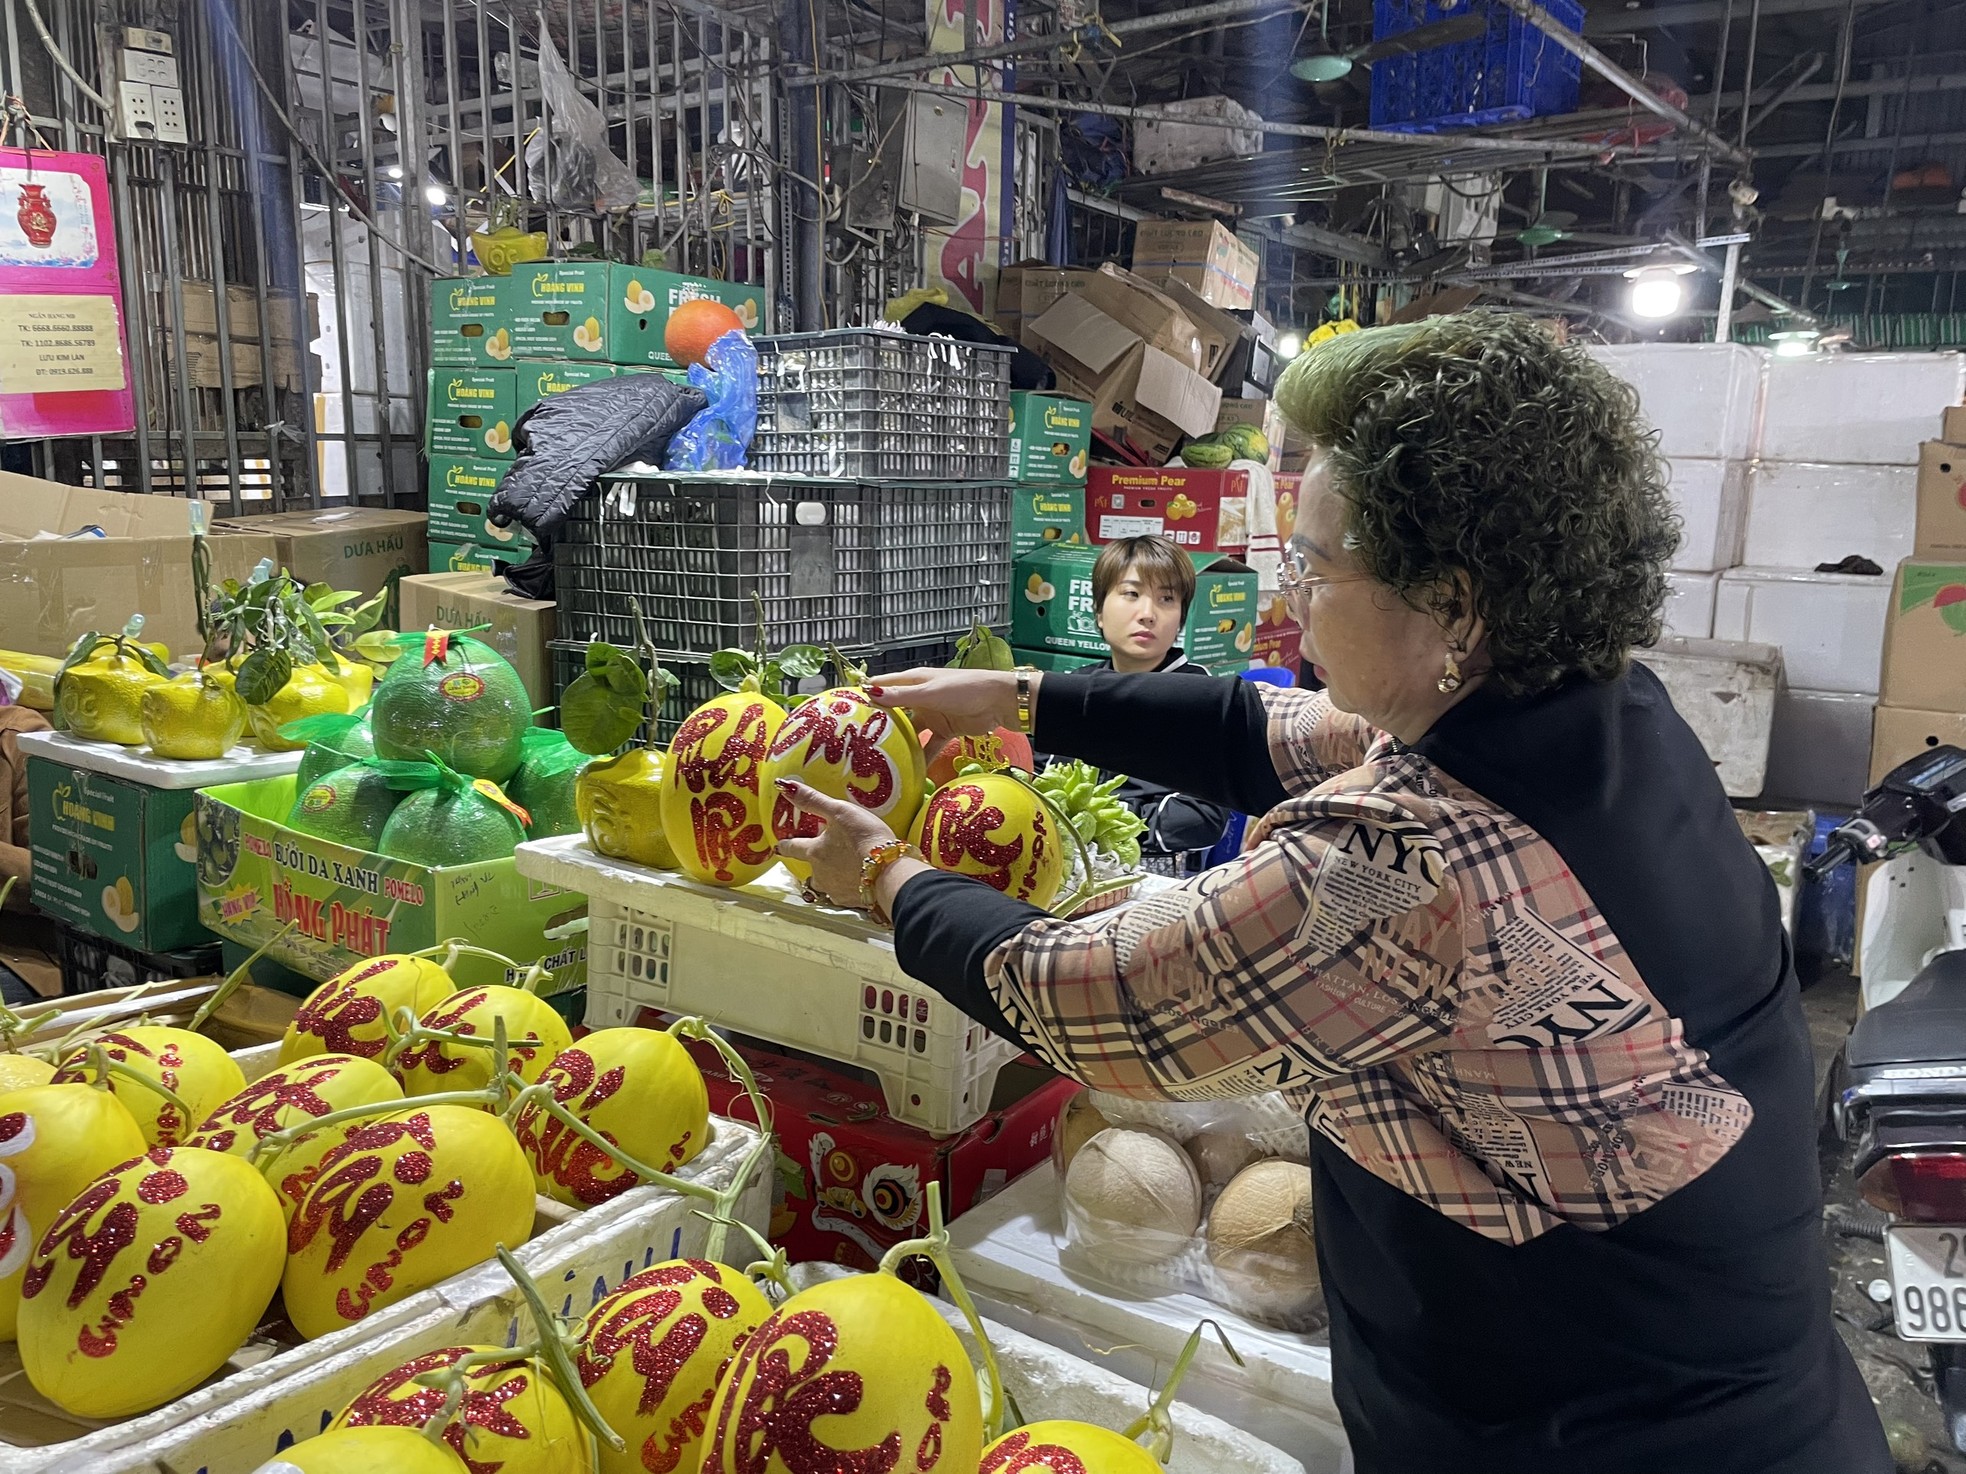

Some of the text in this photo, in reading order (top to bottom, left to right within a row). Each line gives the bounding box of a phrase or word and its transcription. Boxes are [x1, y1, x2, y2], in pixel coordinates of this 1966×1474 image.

[478, 389, 495, 398] VINH
[479, 477, 496, 488] VINH
[1112, 474, 1186, 487] Premium Pear
[344, 535, 404, 559] DƯA HẤU
[436, 606, 463, 627] DƯA
[1045, 636, 1076, 648] QUEEN
[308, 853, 330, 880] DA
[332, 860, 379, 895] XANH
[1335, 854, 1422, 893] NEW YORK CITY
[384, 877, 425, 907] POMELO
[330, 900, 392, 957] PHÁT
[544, 946, 576, 970] CHẤT
[1354, 997, 1386, 1013] CULTURE
[1503, 971, 1597, 1030] NEW YORK CITY
